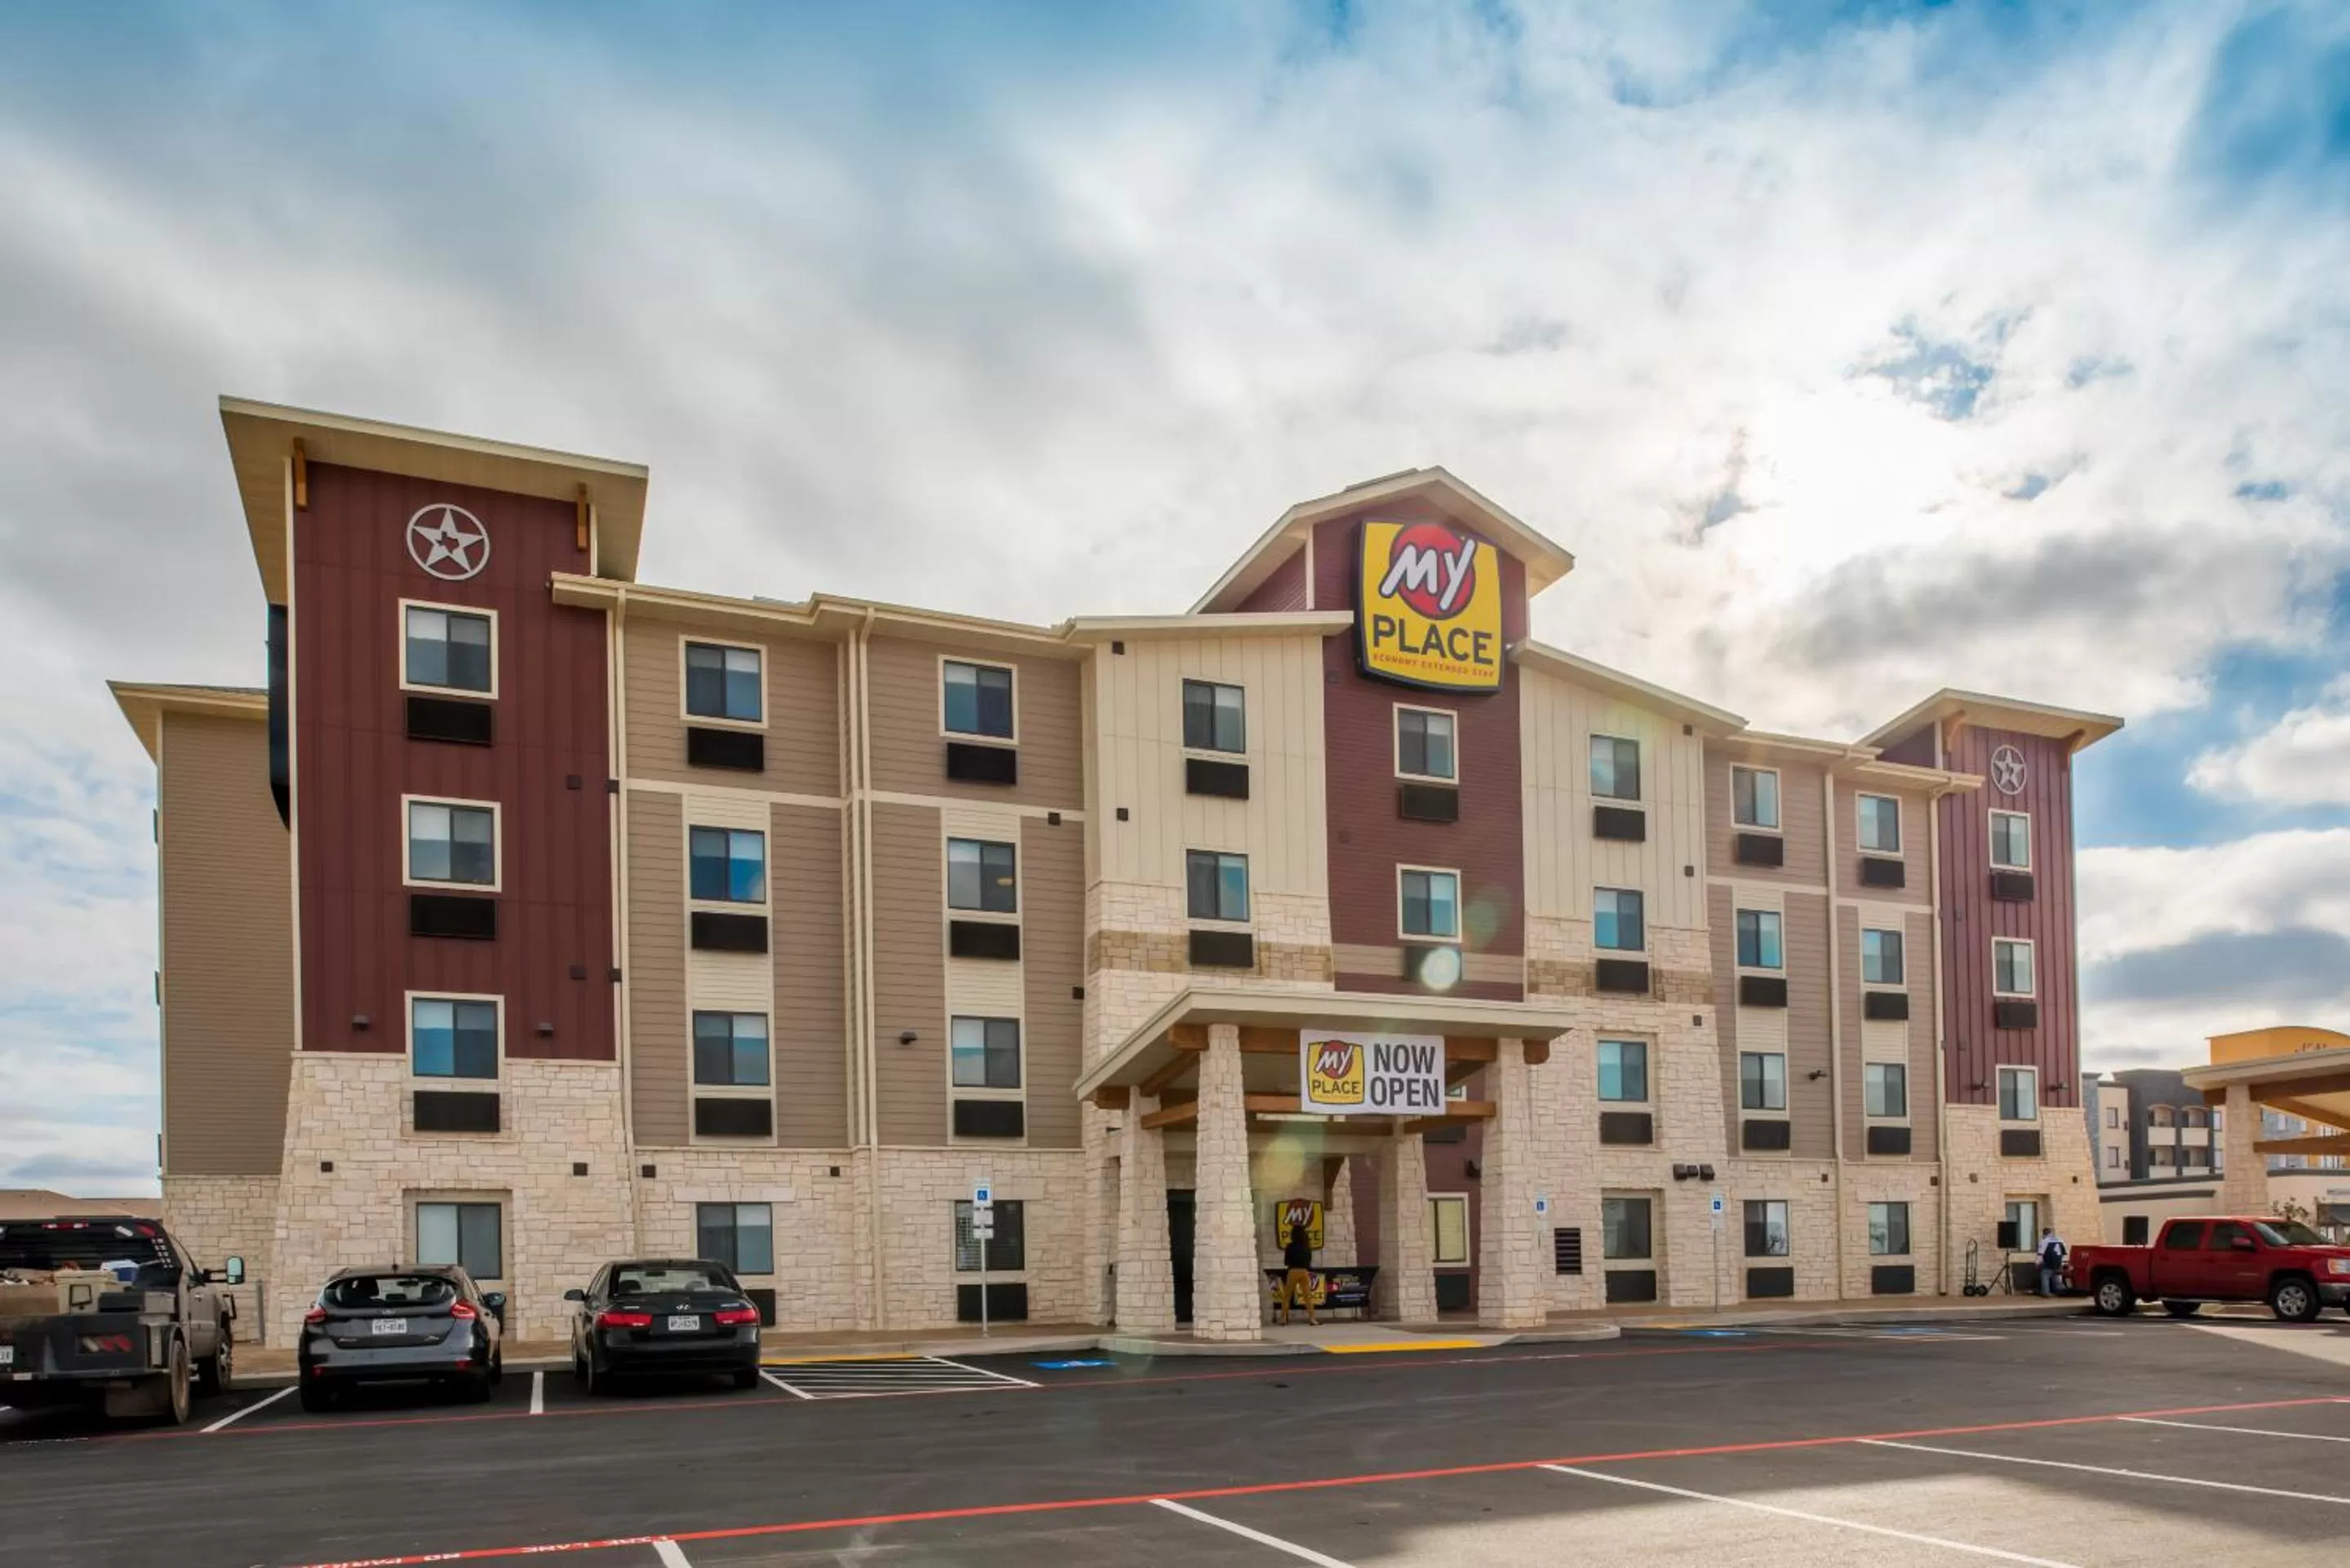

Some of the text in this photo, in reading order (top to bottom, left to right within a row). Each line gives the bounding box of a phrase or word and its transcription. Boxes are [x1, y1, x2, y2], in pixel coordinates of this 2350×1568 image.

[1380, 538, 1476, 611] MY
[1372, 613, 1494, 666] PLACE
[1373, 653, 1418, 667] ECONOMY
[1315, 1044, 1354, 1075] MY
[1373, 1043, 1436, 1074] NOW
[1312, 1080, 1362, 1095] PLACE
[1370, 1076, 1440, 1107] OPEN
[1284, 1202, 1314, 1227] MY
